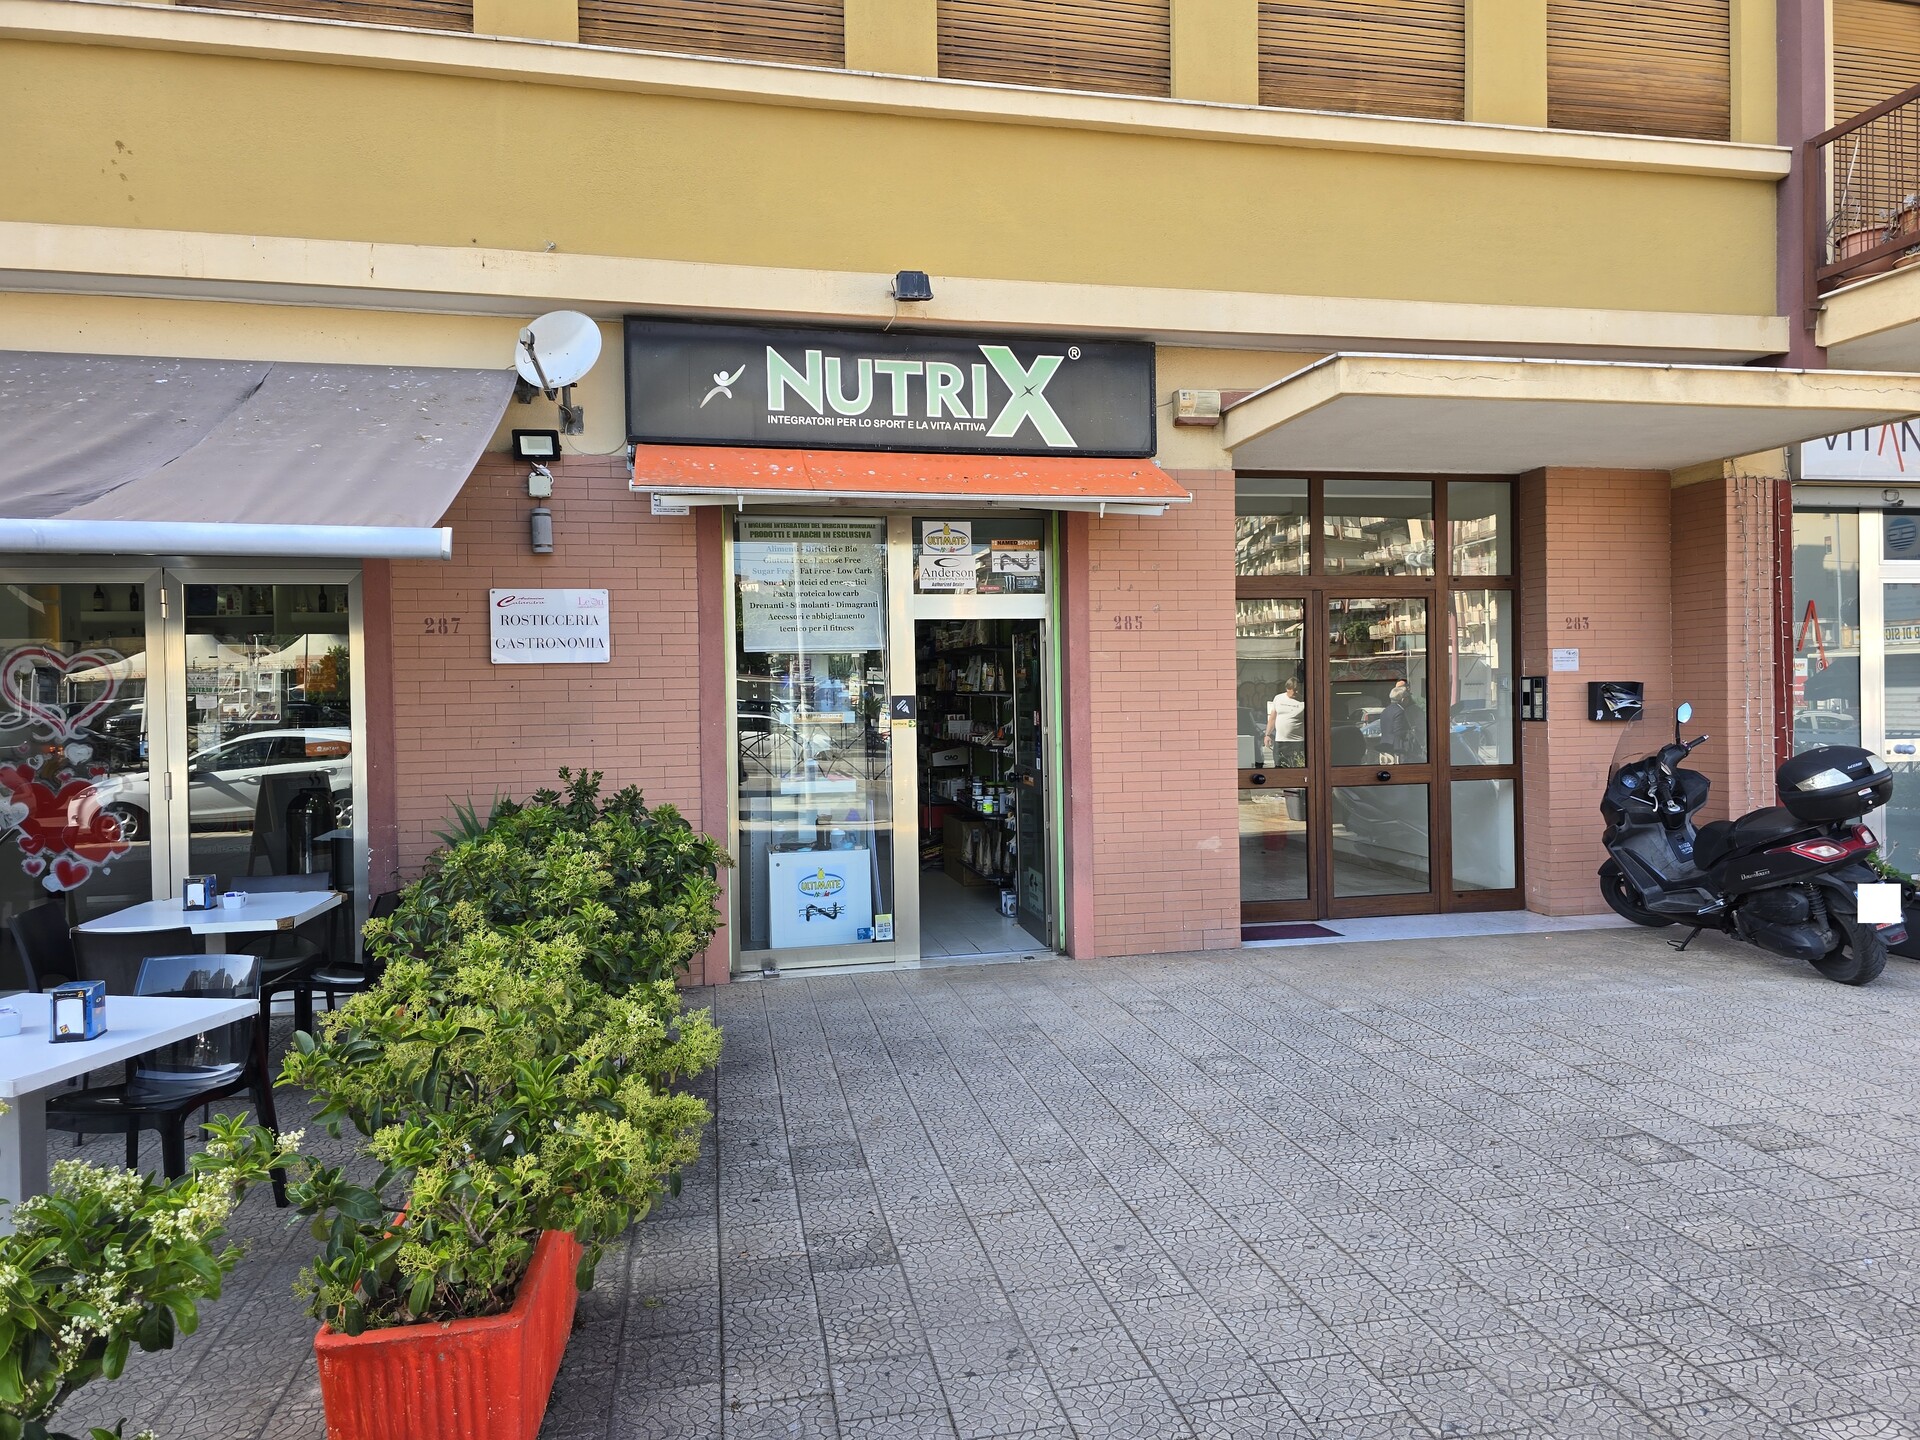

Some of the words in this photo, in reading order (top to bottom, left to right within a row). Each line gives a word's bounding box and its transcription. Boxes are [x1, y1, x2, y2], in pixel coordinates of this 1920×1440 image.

[767, 415, 835, 426] INTEGRATORI
[836, 417, 857, 427] PER
[858, 419, 872, 428] LO
[873, 419, 906, 429] SPORT
[908, 420, 914, 430] E
[915, 421, 929, 430] LA
[930, 421, 952, 431] VITA
[953, 422, 986, 432] ATTIVA
[928, 536, 966, 546] ULTIMATE
[752, 568, 774, 576] Sugar
[922, 568, 974, 578] Anderson
[836, 600, 878, 609] Dimagranti
[500, 614, 600, 626] ROSTICCERIA
[812, 612, 866, 620] abbigliamento
[424, 618, 461, 634] 287
[1114, 616, 1142, 630] 285
[1565, 616, 1590, 630] 283
[495, 637, 605, 650] GASTRONOMIA
[800, 880, 842, 890] ULTIMATE
